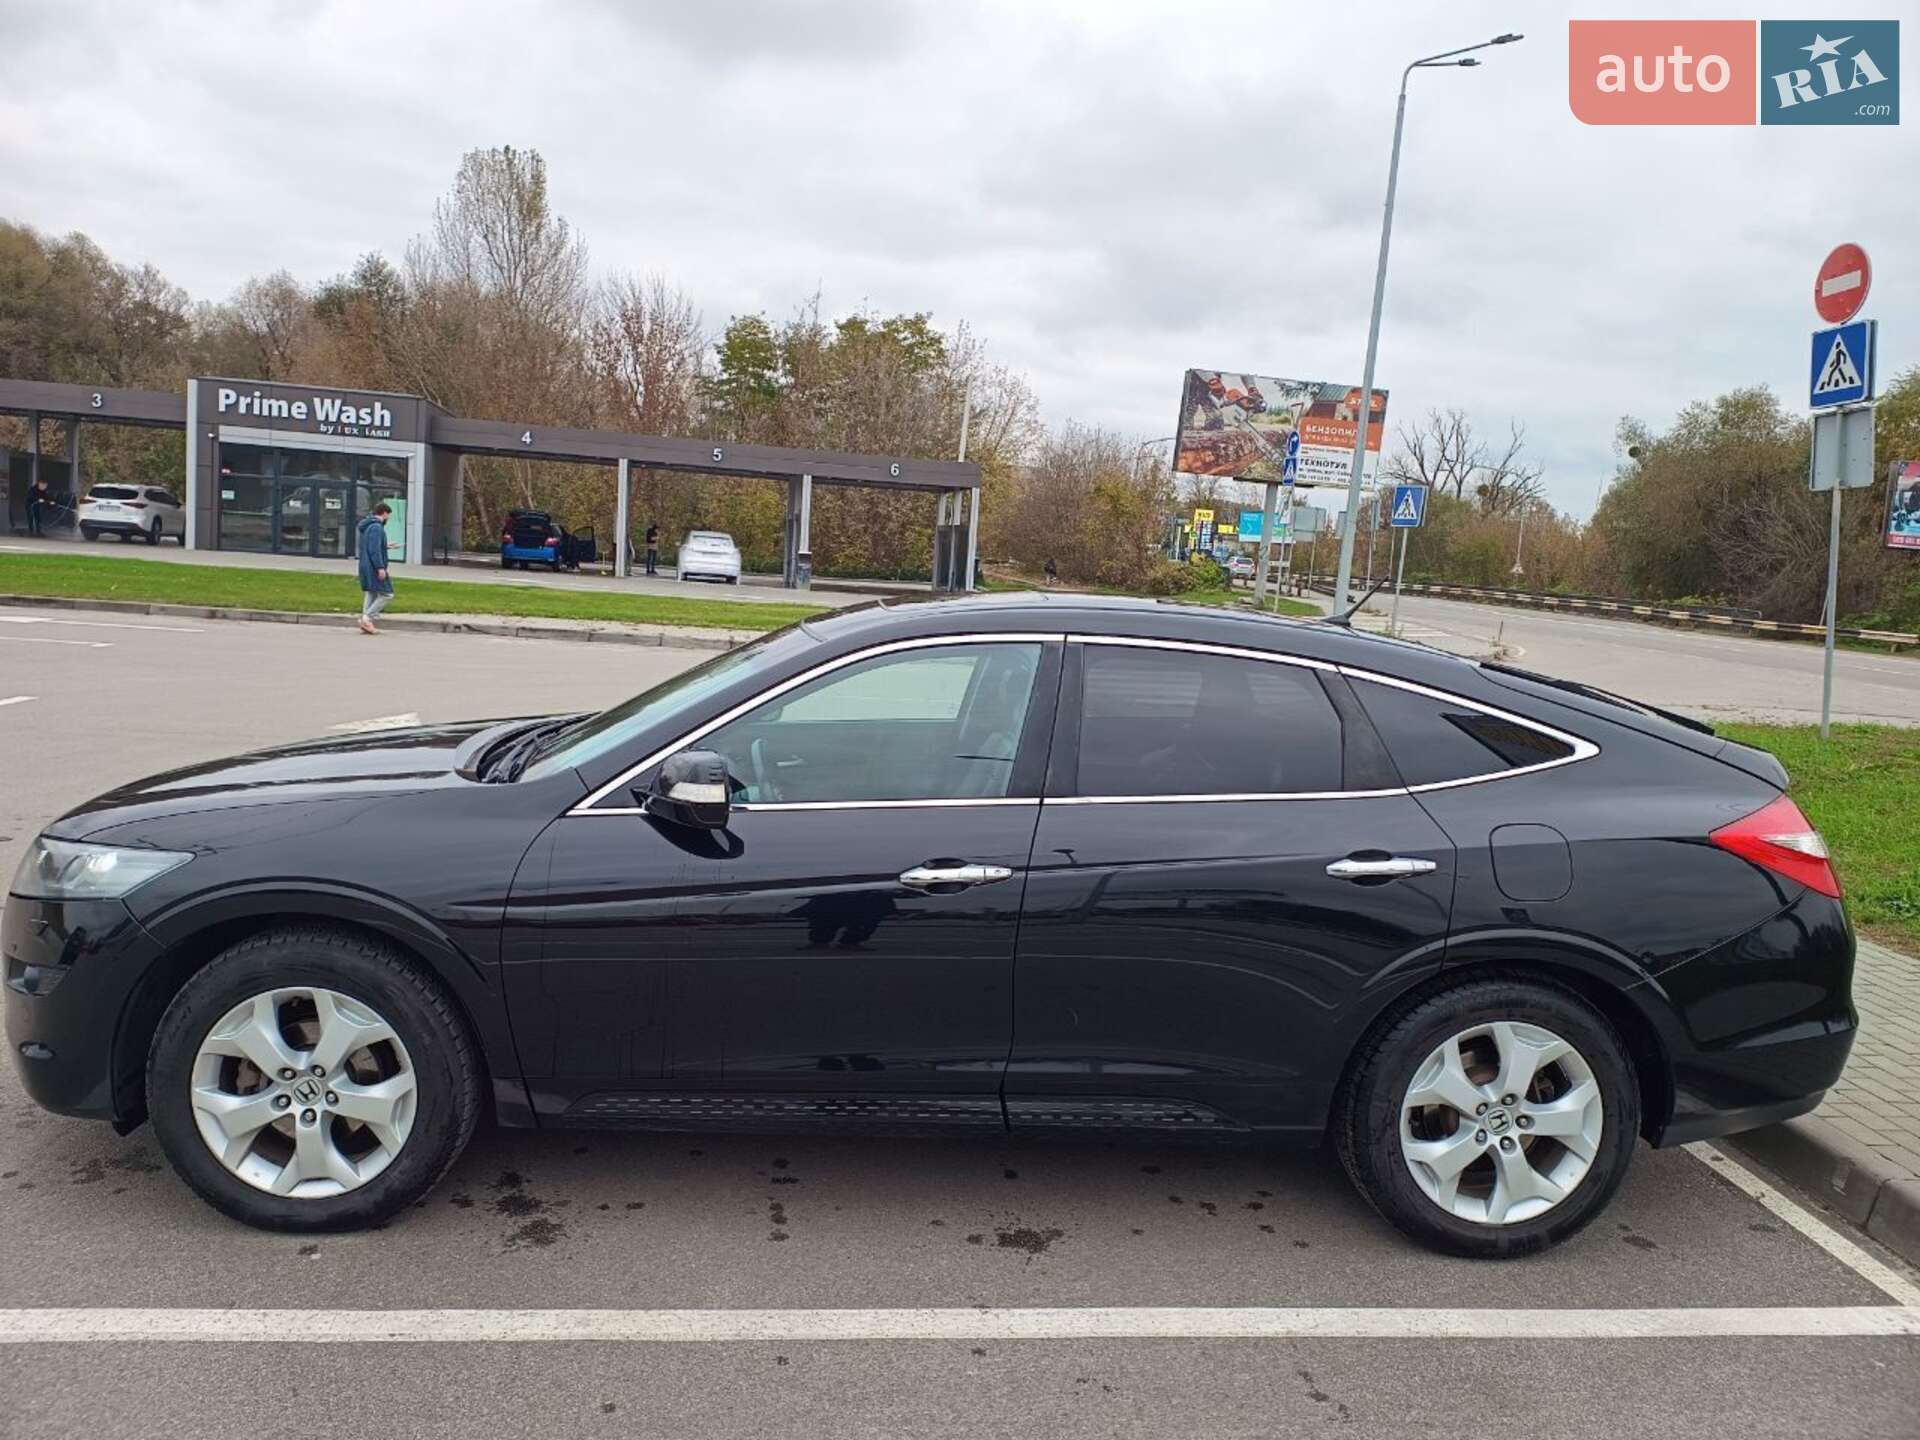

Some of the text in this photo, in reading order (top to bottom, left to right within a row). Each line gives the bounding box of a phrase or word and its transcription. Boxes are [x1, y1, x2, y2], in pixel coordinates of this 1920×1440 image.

[91, 393, 102, 407] 3
[218, 387, 392, 427] Prime Wash
[320, 423, 335, 434] by
[1305, 424, 1359, 436] БЕНЗОПИЛ
[521, 431, 532, 445] 4
[713, 448, 722, 461] 5
[890, 463, 900, 476] 6
